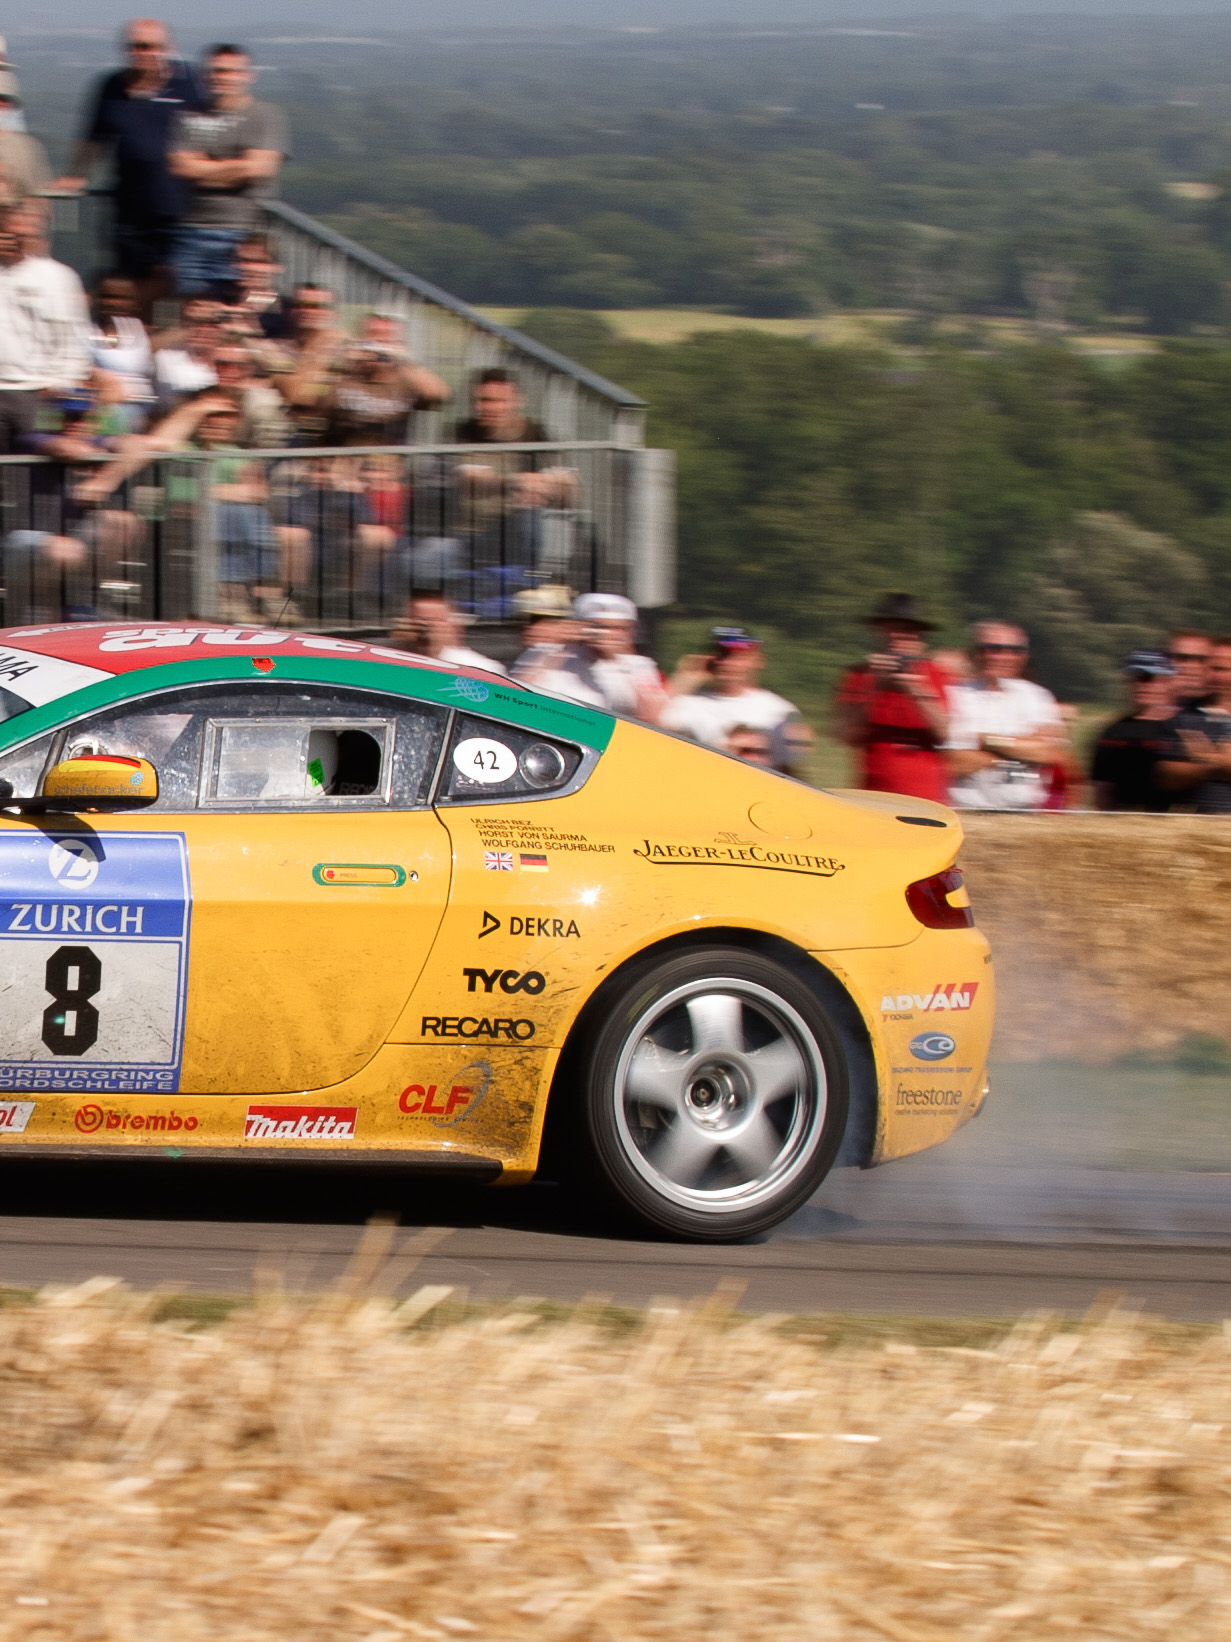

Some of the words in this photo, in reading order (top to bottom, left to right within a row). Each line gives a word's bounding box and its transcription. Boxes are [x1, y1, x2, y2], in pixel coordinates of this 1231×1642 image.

[512, 697, 538, 710] Sport
[473, 750, 500, 769] 42
[470, 817, 509, 825] ULRICH
[478, 830, 514, 838] HORST
[518, 831, 540, 839] VON
[542, 833, 588, 842] SAURMA
[481, 838, 543, 849] WOLFGANG
[544, 841, 616, 853] SCHUHBAUER
[8, 903, 145, 933] ZURICH
[510, 916, 581, 938] DEKRA
[462, 967, 546, 995] TYCO
[41, 945, 102, 1056] 8
[880, 991, 971, 1012] ADVAN
[421, 1016, 536, 1041] RECARO
[398, 1084, 475, 1114] CLF
[895, 1083, 963, 1106] freestone
[105, 1111, 199, 1131] brembo
